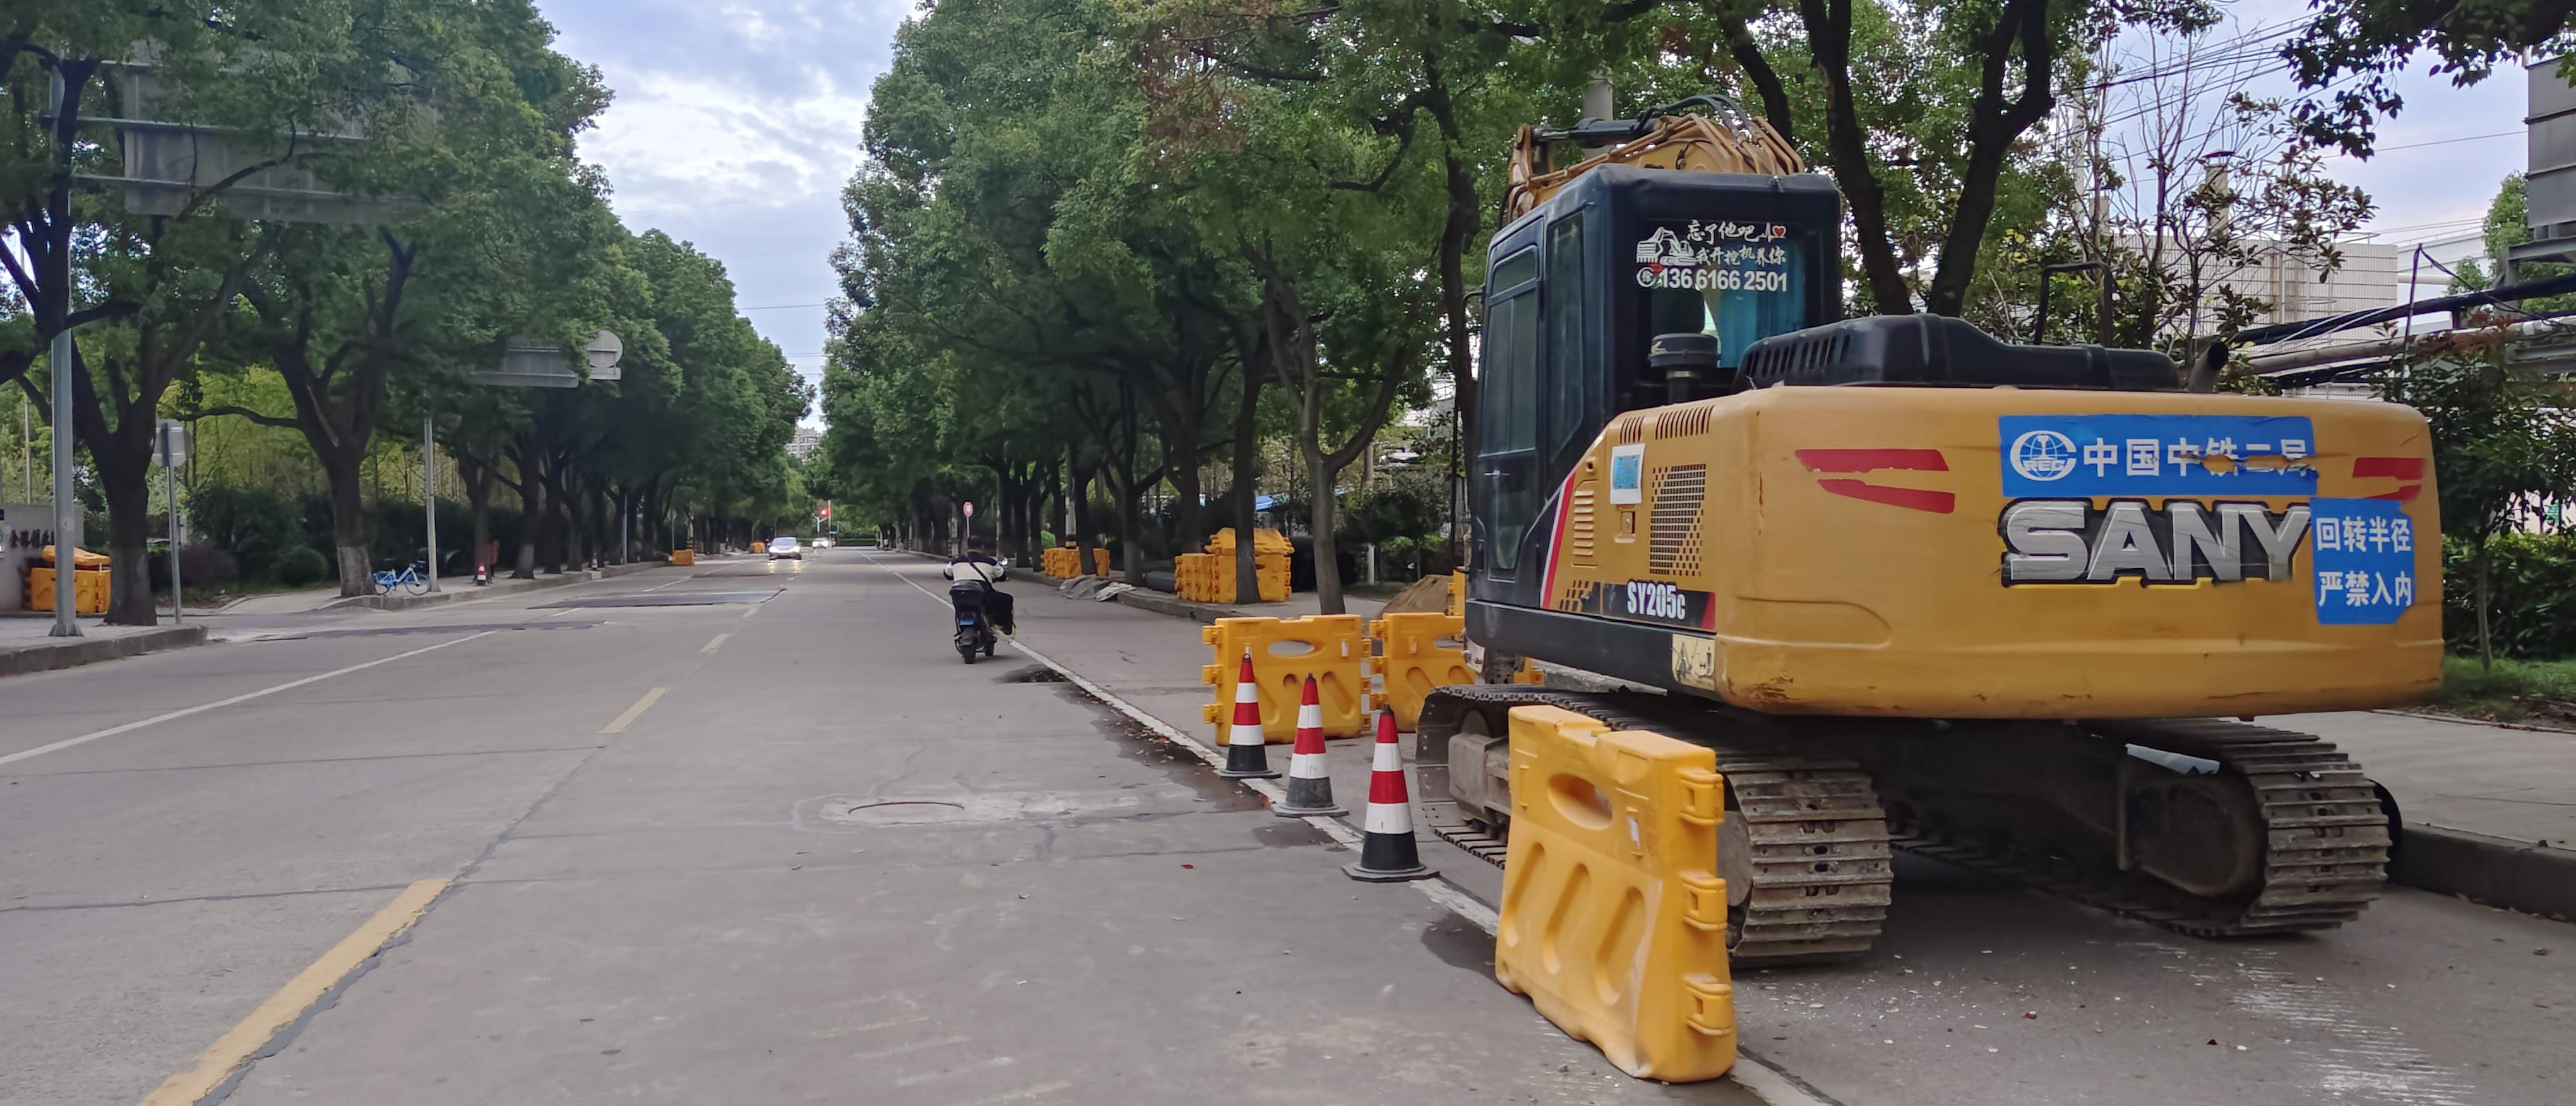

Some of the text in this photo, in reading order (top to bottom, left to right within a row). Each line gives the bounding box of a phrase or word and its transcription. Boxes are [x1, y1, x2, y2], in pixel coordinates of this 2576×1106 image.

[1686, 220, 1760, 245] 忘了他吧
[1695, 244, 1787, 267] 我开挖机养你
[1659, 268, 1787, 292] 136 6166 2501
[2003, 499, 2311, 583] SANY
[2316, 516, 2412, 553] 回转半径
[2318, 570, 2412, 607] 严禁入内
